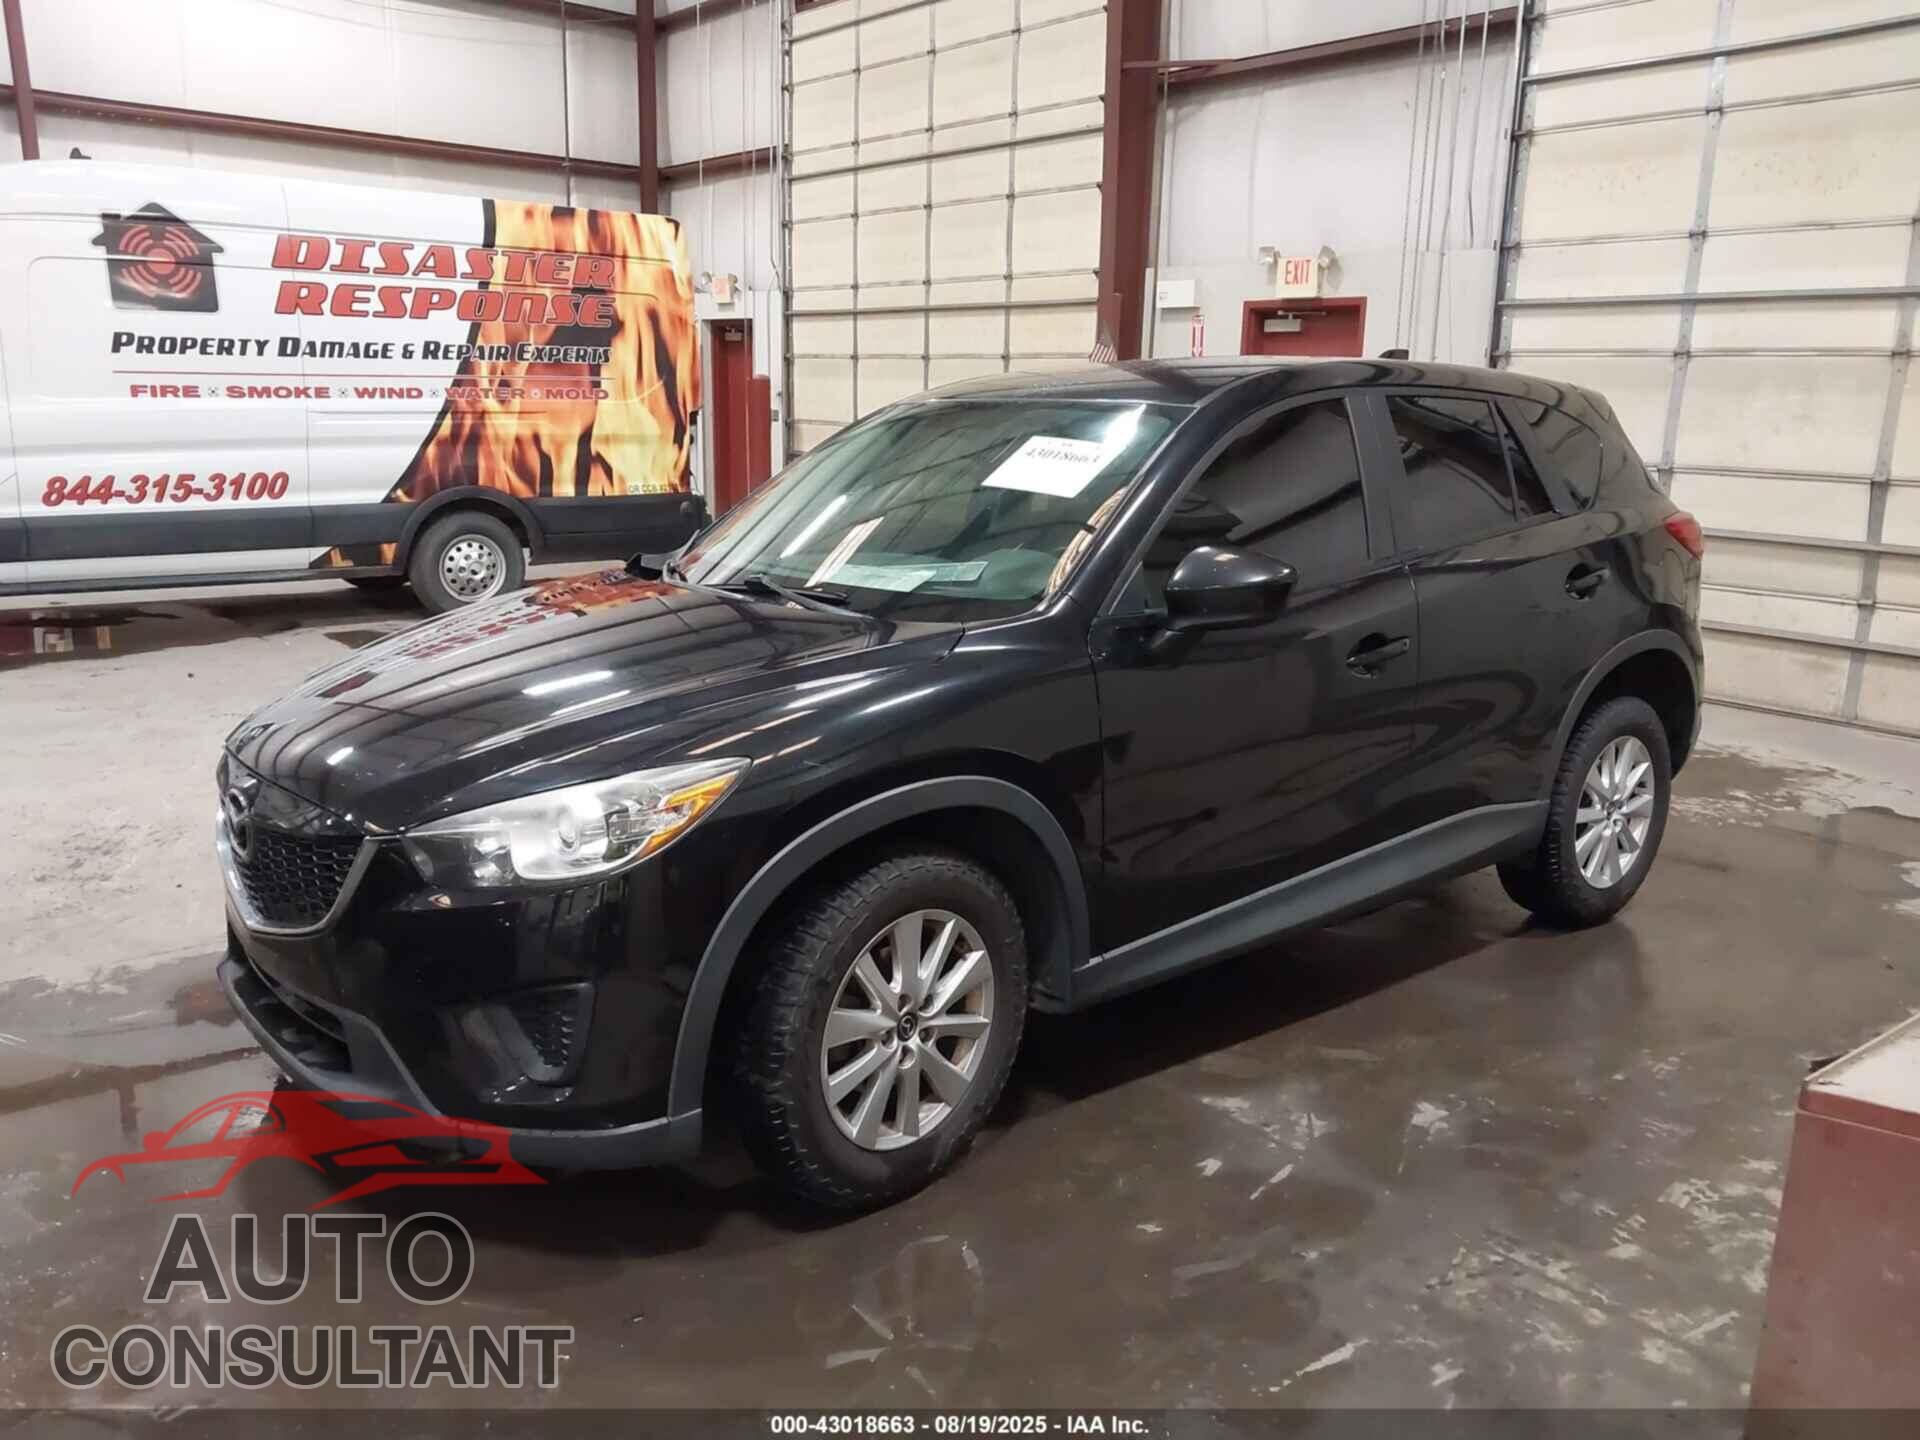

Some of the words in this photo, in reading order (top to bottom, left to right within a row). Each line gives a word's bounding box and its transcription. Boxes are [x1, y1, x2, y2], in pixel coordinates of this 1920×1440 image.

[271, 234, 616, 288] DISASTER
[1284, 259, 1312, 285] EXIT
[274, 280, 616, 328] RESPONSE
[111, 331, 270, 357] PROPERTY
[277, 336, 395, 360] DAMAGE
[401, 340, 415, 360] &
[129, 384, 202, 399] FIRE
[225, 385, 332, 400] SMOKE
[353, 386, 424, 400] WIND
[444, 386, 526, 401] WATER
[544, 388, 610, 401] MOLD
[42, 472, 290, 508] 844-315-3100
